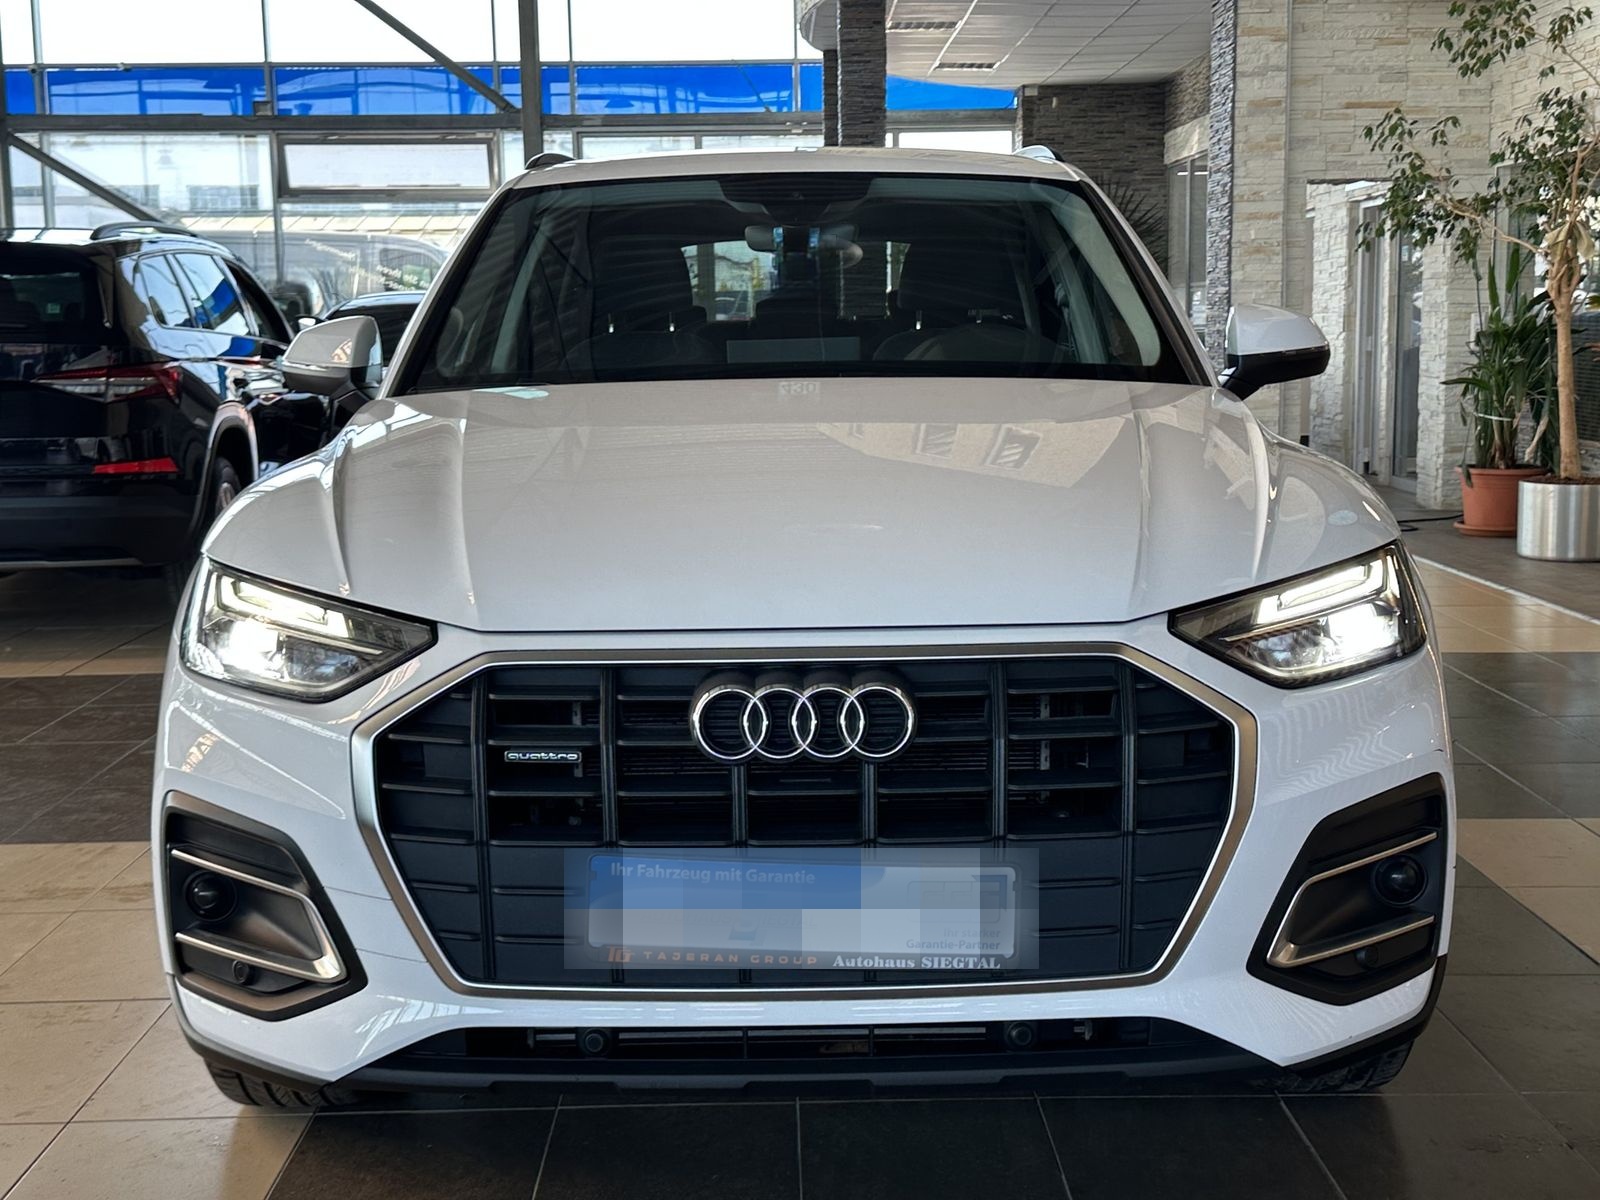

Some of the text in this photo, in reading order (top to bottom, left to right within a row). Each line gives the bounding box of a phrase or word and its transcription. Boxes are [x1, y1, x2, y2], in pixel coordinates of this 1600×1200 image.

[507, 752, 579, 761] quattro
[610, 862, 817, 884] Ihr Fahrzeug mit Garantie
[905, 938, 1001, 950] Garantie-Partner
[642, 950, 740, 964] TAJERAN
[750, 954, 818, 966] GROUP
[832, 955, 1001, 970] Autohaus SIEGTAL
